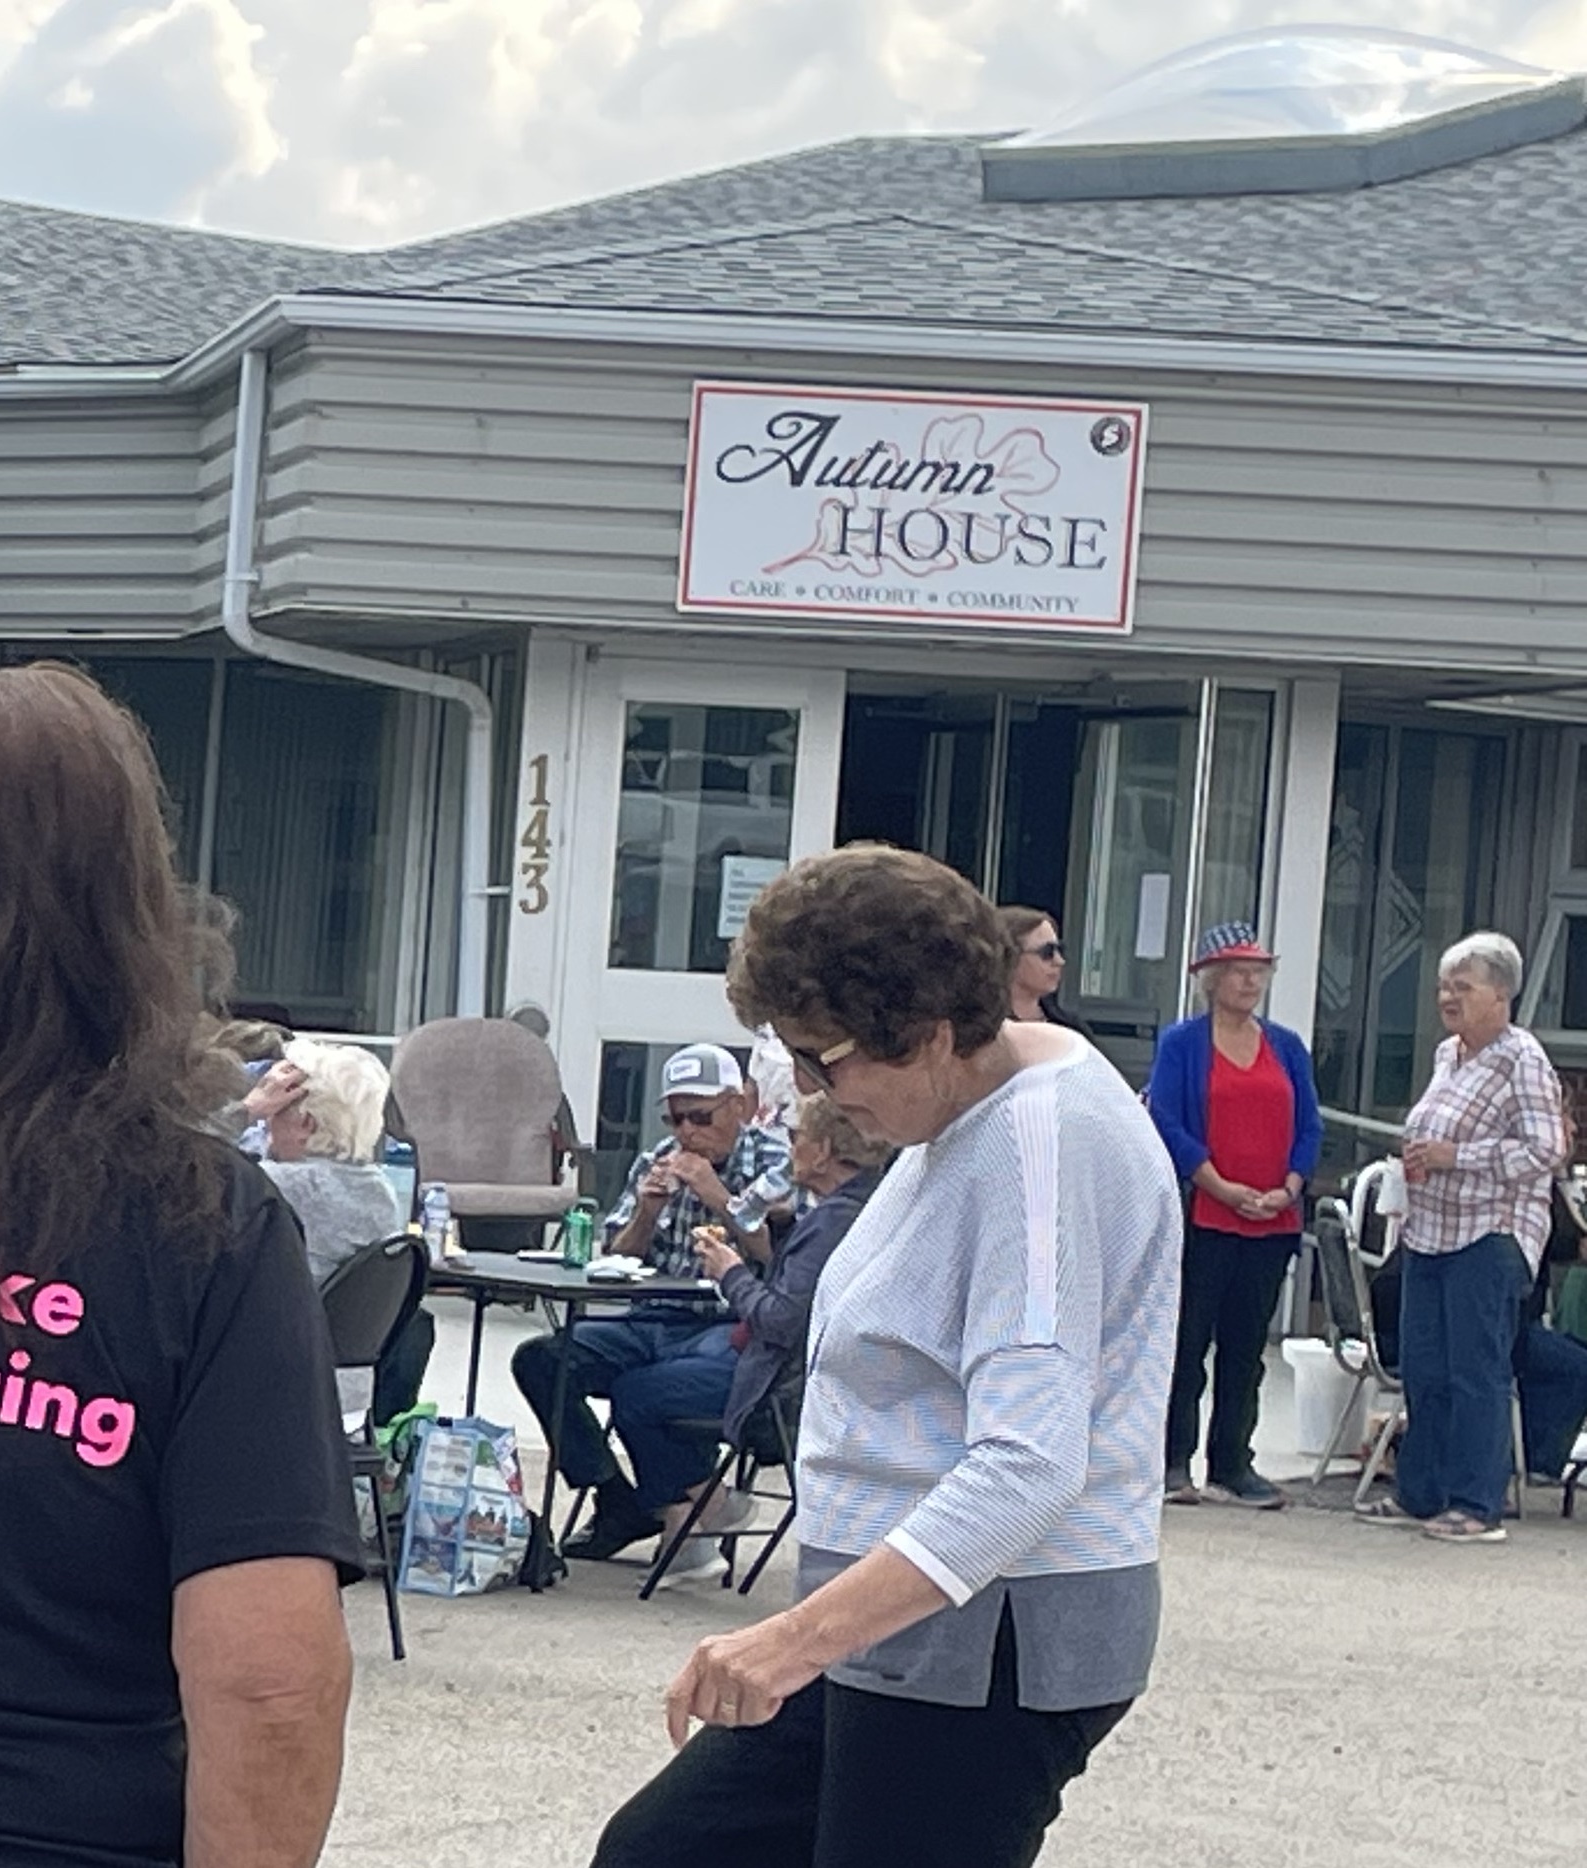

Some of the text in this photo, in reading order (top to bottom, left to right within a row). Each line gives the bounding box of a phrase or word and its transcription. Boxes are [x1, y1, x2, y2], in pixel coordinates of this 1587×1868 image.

[716, 411, 995, 495] Autumn
[832, 503, 1106, 570] HOUSE
[730, 579, 1080, 613] CARE COMFORT COMMUNITY
[518, 752, 552, 915] 143
